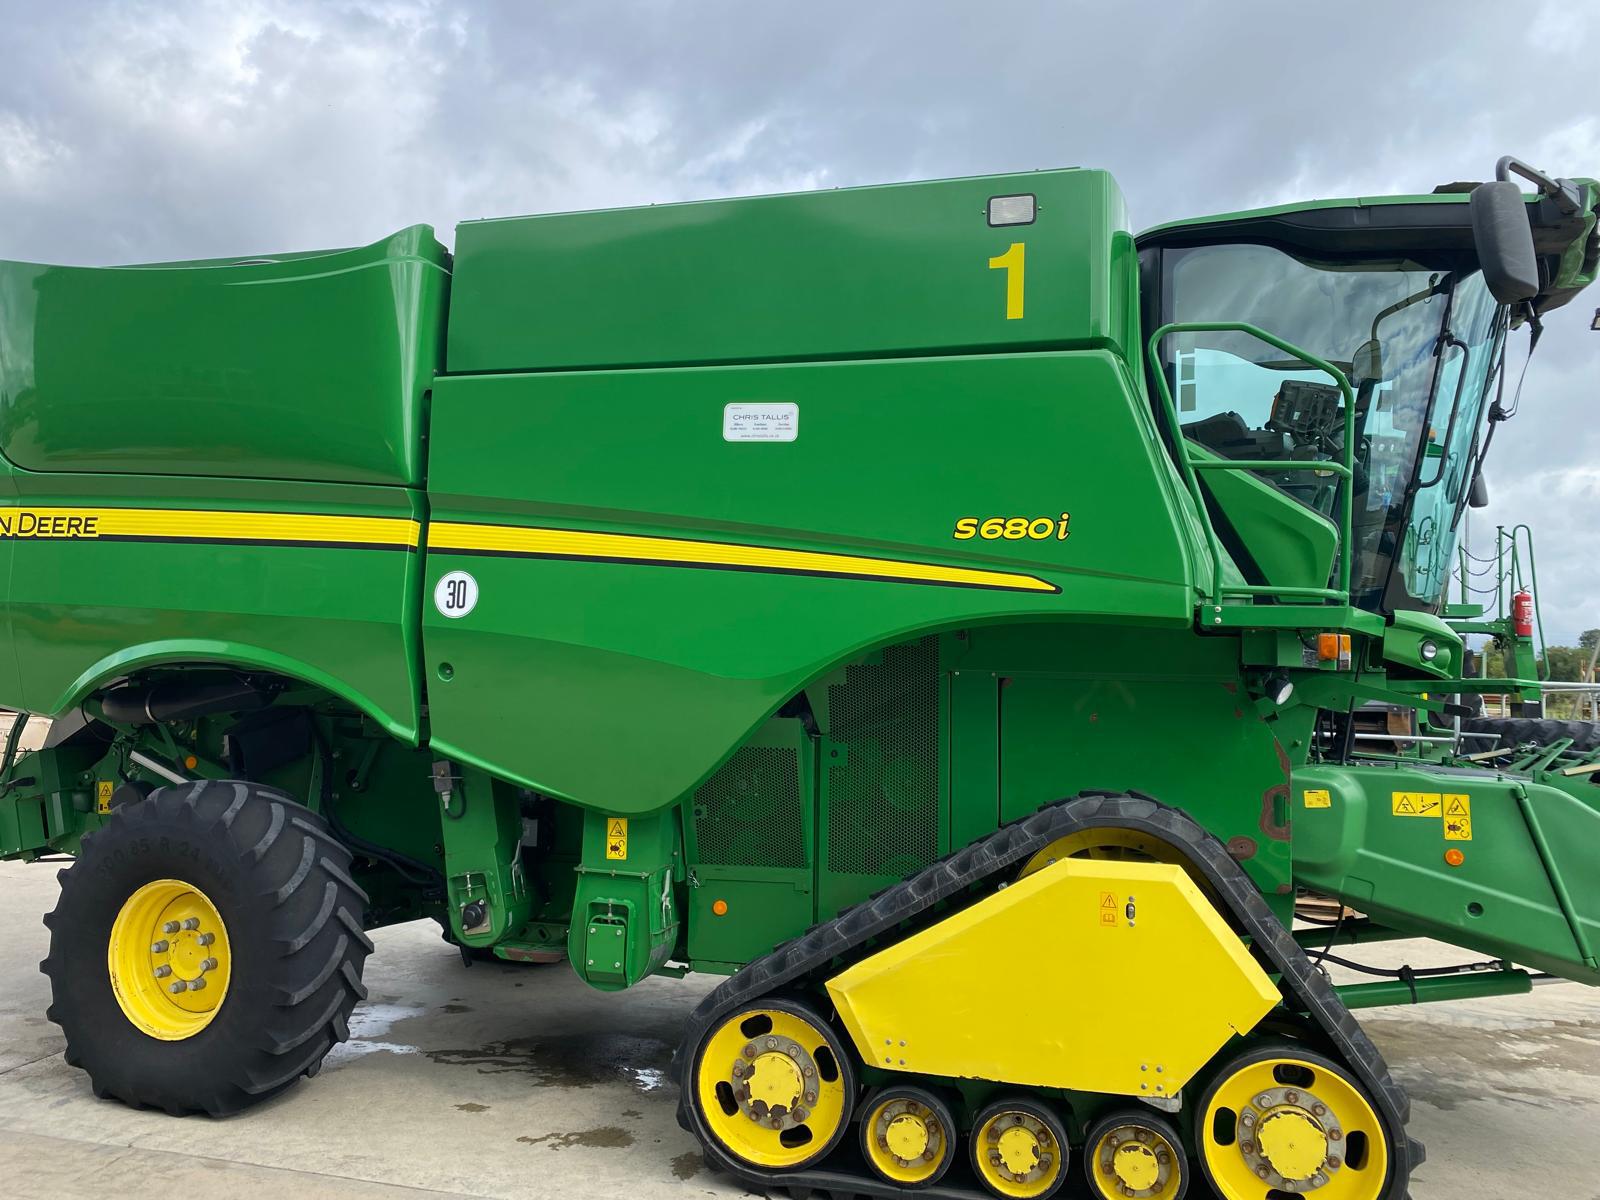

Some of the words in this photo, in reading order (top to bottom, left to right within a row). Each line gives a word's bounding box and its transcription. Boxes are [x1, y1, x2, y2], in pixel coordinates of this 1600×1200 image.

[989, 242, 1025, 320] 1
[18, 512, 98, 535] DEERE
[953, 512, 1070, 541] S680i
[446, 580, 467, 609] 30
